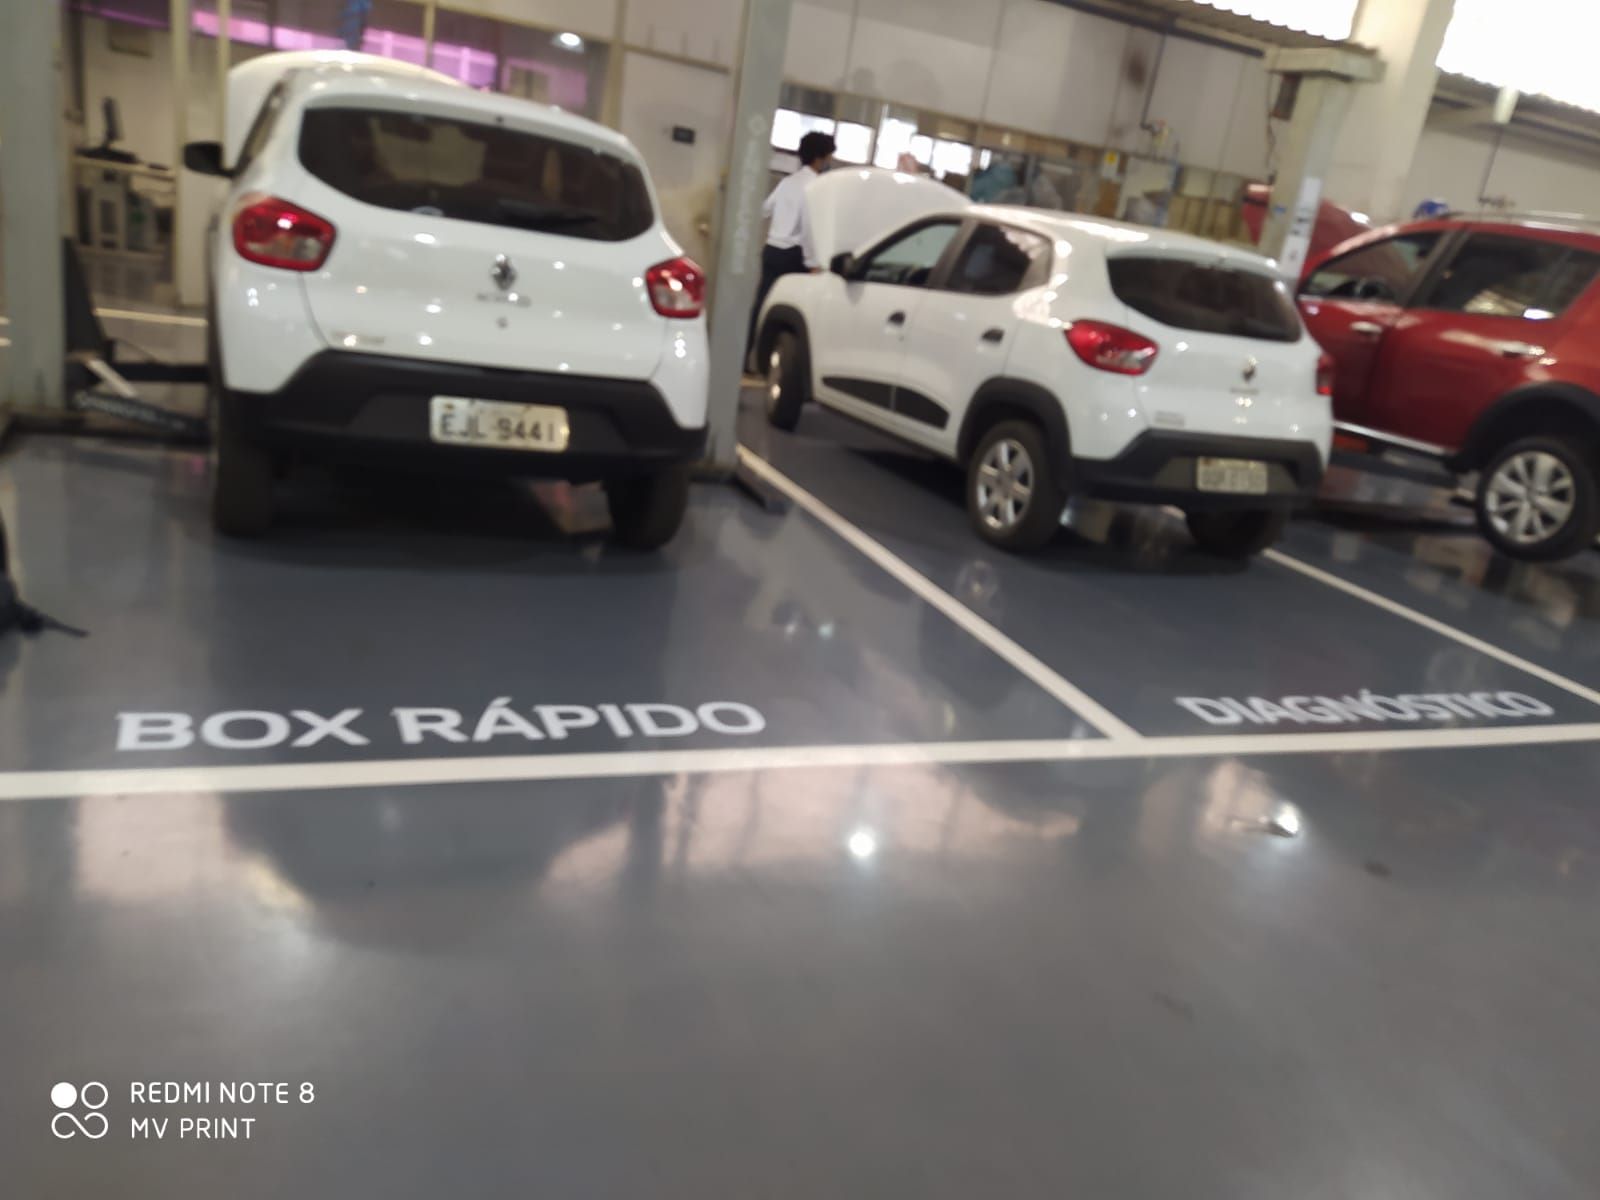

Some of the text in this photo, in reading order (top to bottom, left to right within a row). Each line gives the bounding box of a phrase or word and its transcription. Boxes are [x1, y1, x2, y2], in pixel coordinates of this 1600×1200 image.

[115, 696, 766, 751] BOX RÁPIDO
[1176, 688, 1555, 725] DIAGNÓSTICO
